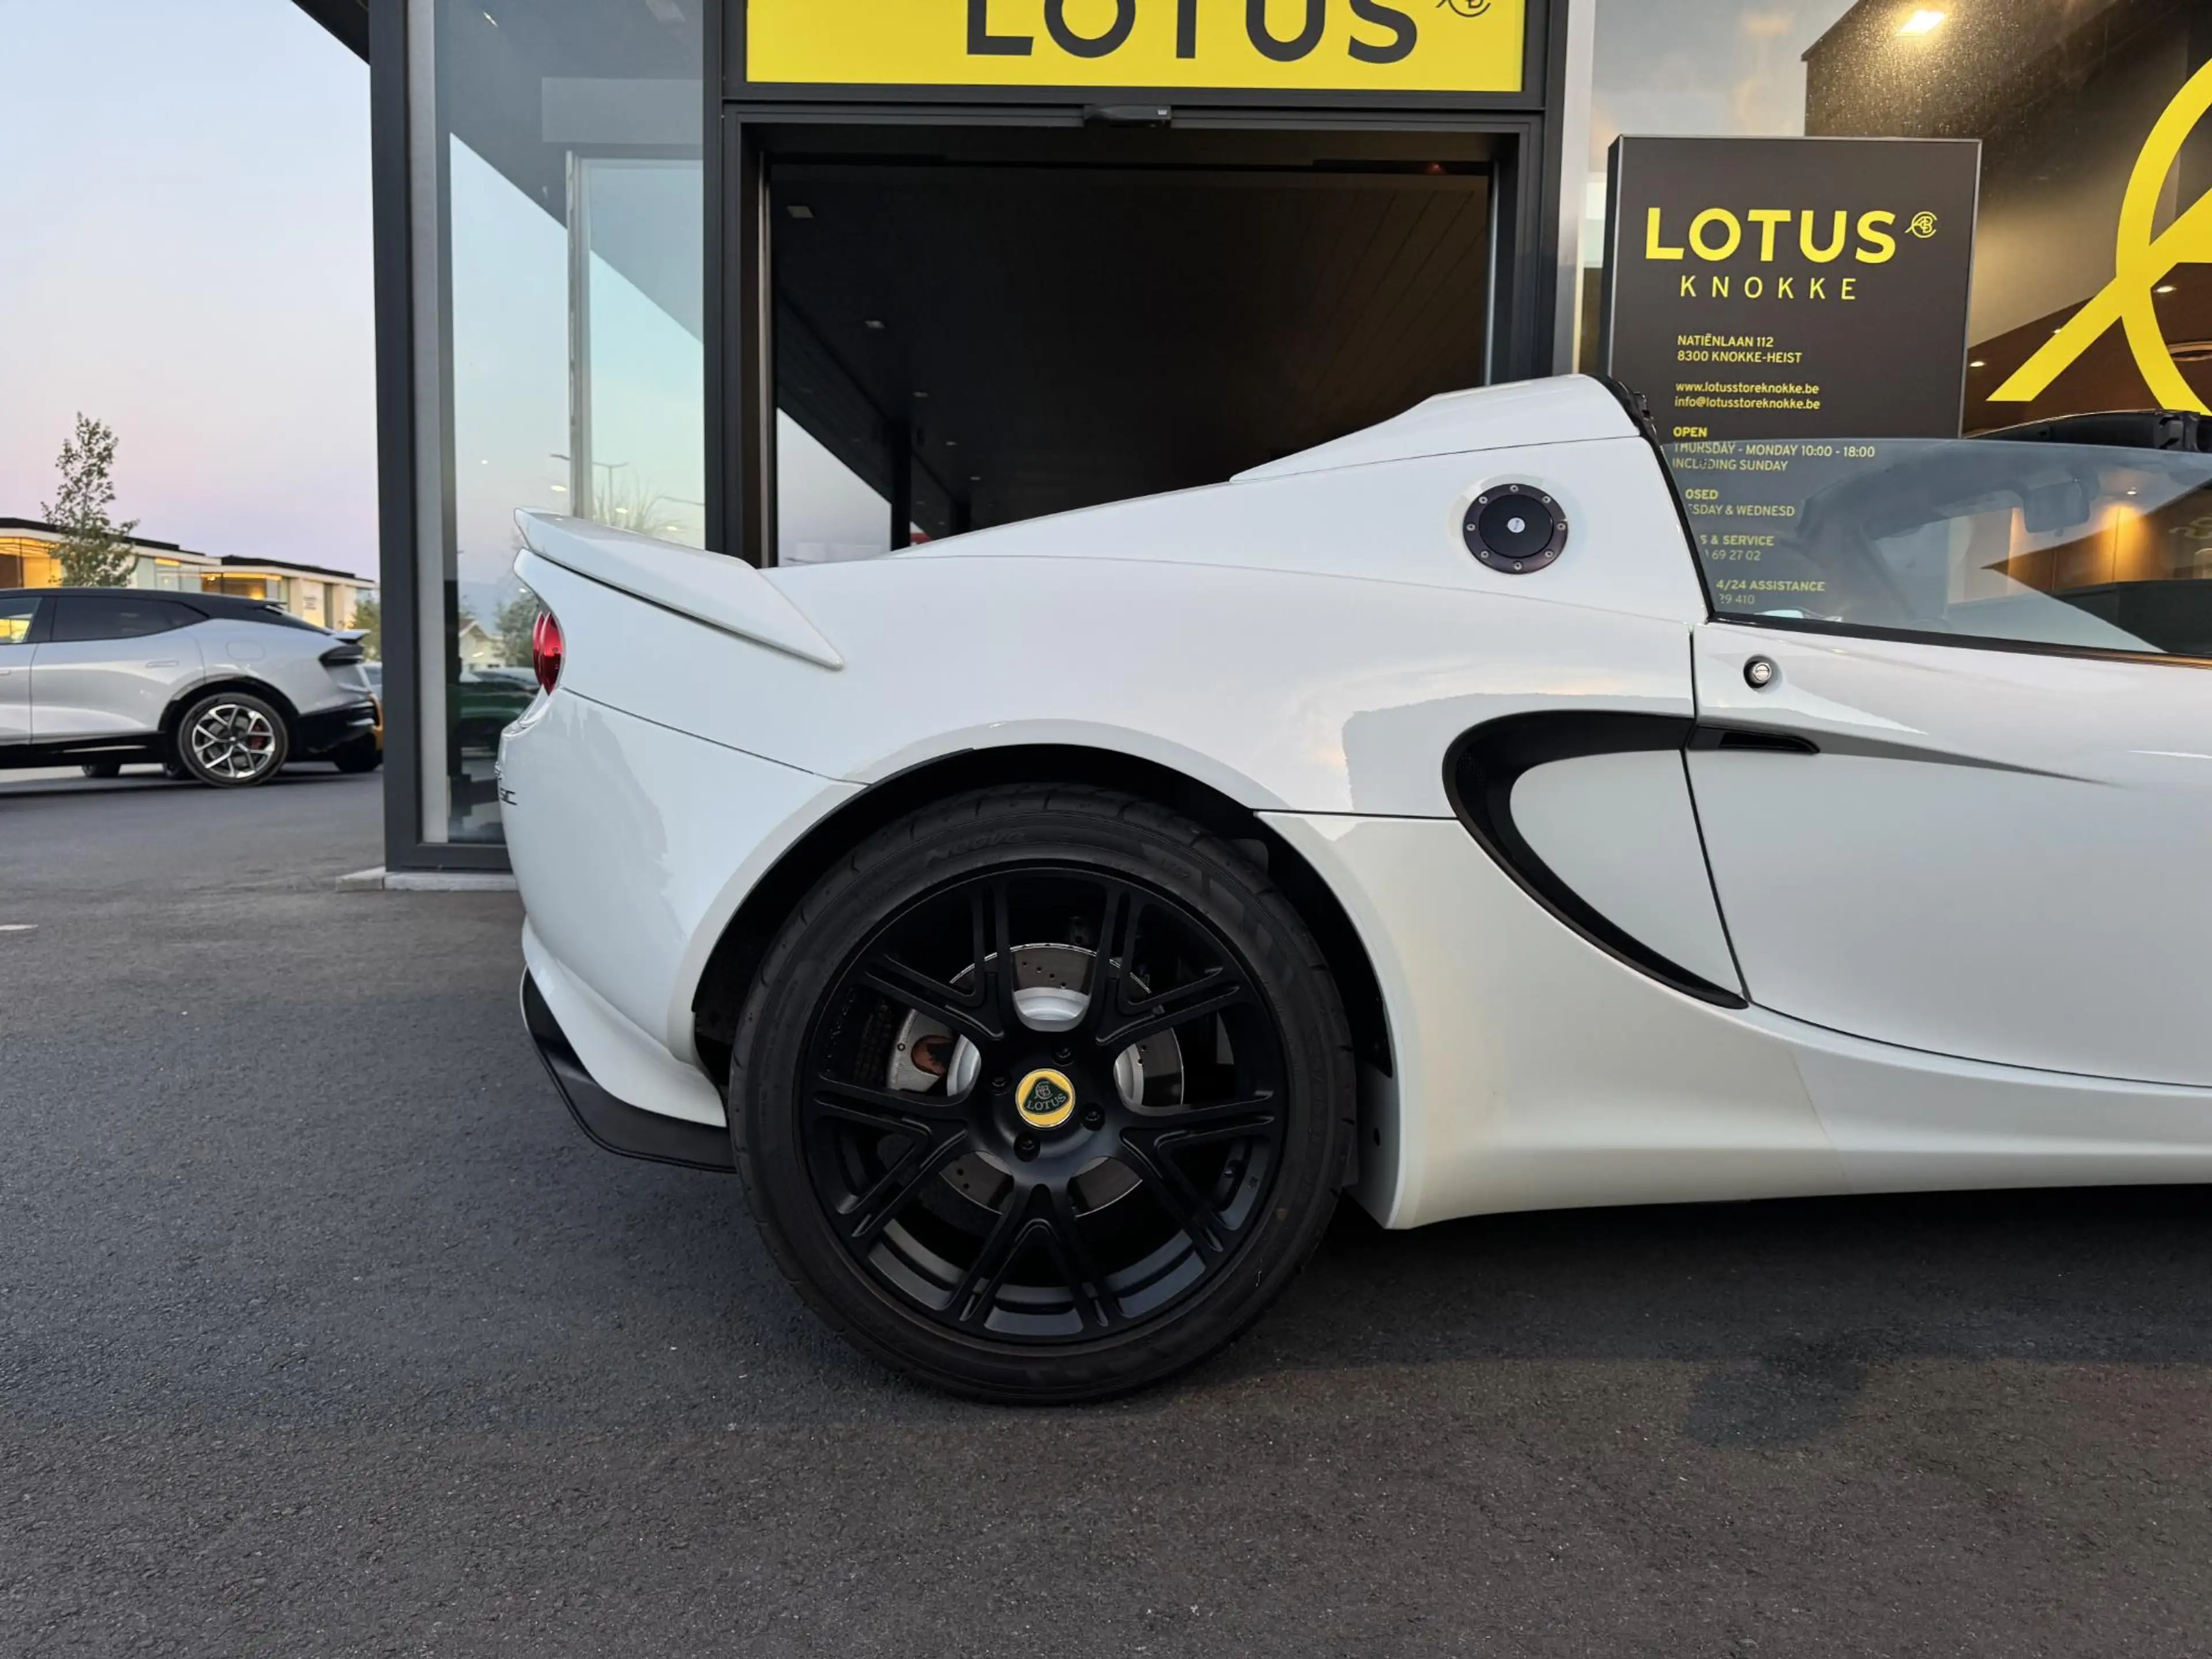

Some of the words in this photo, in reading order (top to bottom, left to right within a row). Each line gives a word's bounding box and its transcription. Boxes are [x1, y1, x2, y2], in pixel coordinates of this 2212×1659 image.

[1645, 207, 1896, 264] LOTUS
[1680, 275, 1856, 301] KNOKKE
[1677, 333, 1753, 347] NATIËNLAAN
[1756, 336, 1774, 347] 112
[1677, 350, 1709, 362] 8300
[1711, 351, 1802, 363] KNOKKE-HEIST
[1675, 381, 1820, 395] www.lotusstoreknokke.be
[1674, 395, 1821, 409] info@lotusstoreknokke.be
[1672, 426, 1708, 438] OPEN
[1673, 441, 1736, 454] THURSDAY
[1745, 444, 1798, 457] MONDAY
[1801, 445, 1833, 457] 10:00
[1843, 445, 1876, 458] 18:00
[1672, 457, 1737, 471] INCLUDING
[1738, 460, 1789, 472] SUNDAY
[1685, 488, 1719, 500] OSED
[1688, 503, 1724, 515] SDAY
[1725, 504, 1734, 516] &
[1736, 504, 1796, 517] WEDNESD
[1710, 535, 1719, 546] &
[1722, 535, 1775, 547] SERVICE
[1711, 549, 1727, 560] 69
[1729, 549, 1744, 561] 27
[1745, 550, 1762, 562] 02
[1715, 578, 1747, 591] 4/24
[1748, 579, 1825, 592] ASSISTANCE
[1735, 594, 1755, 605] 410
[1025, 1092, 1067, 1111] LOTUS
